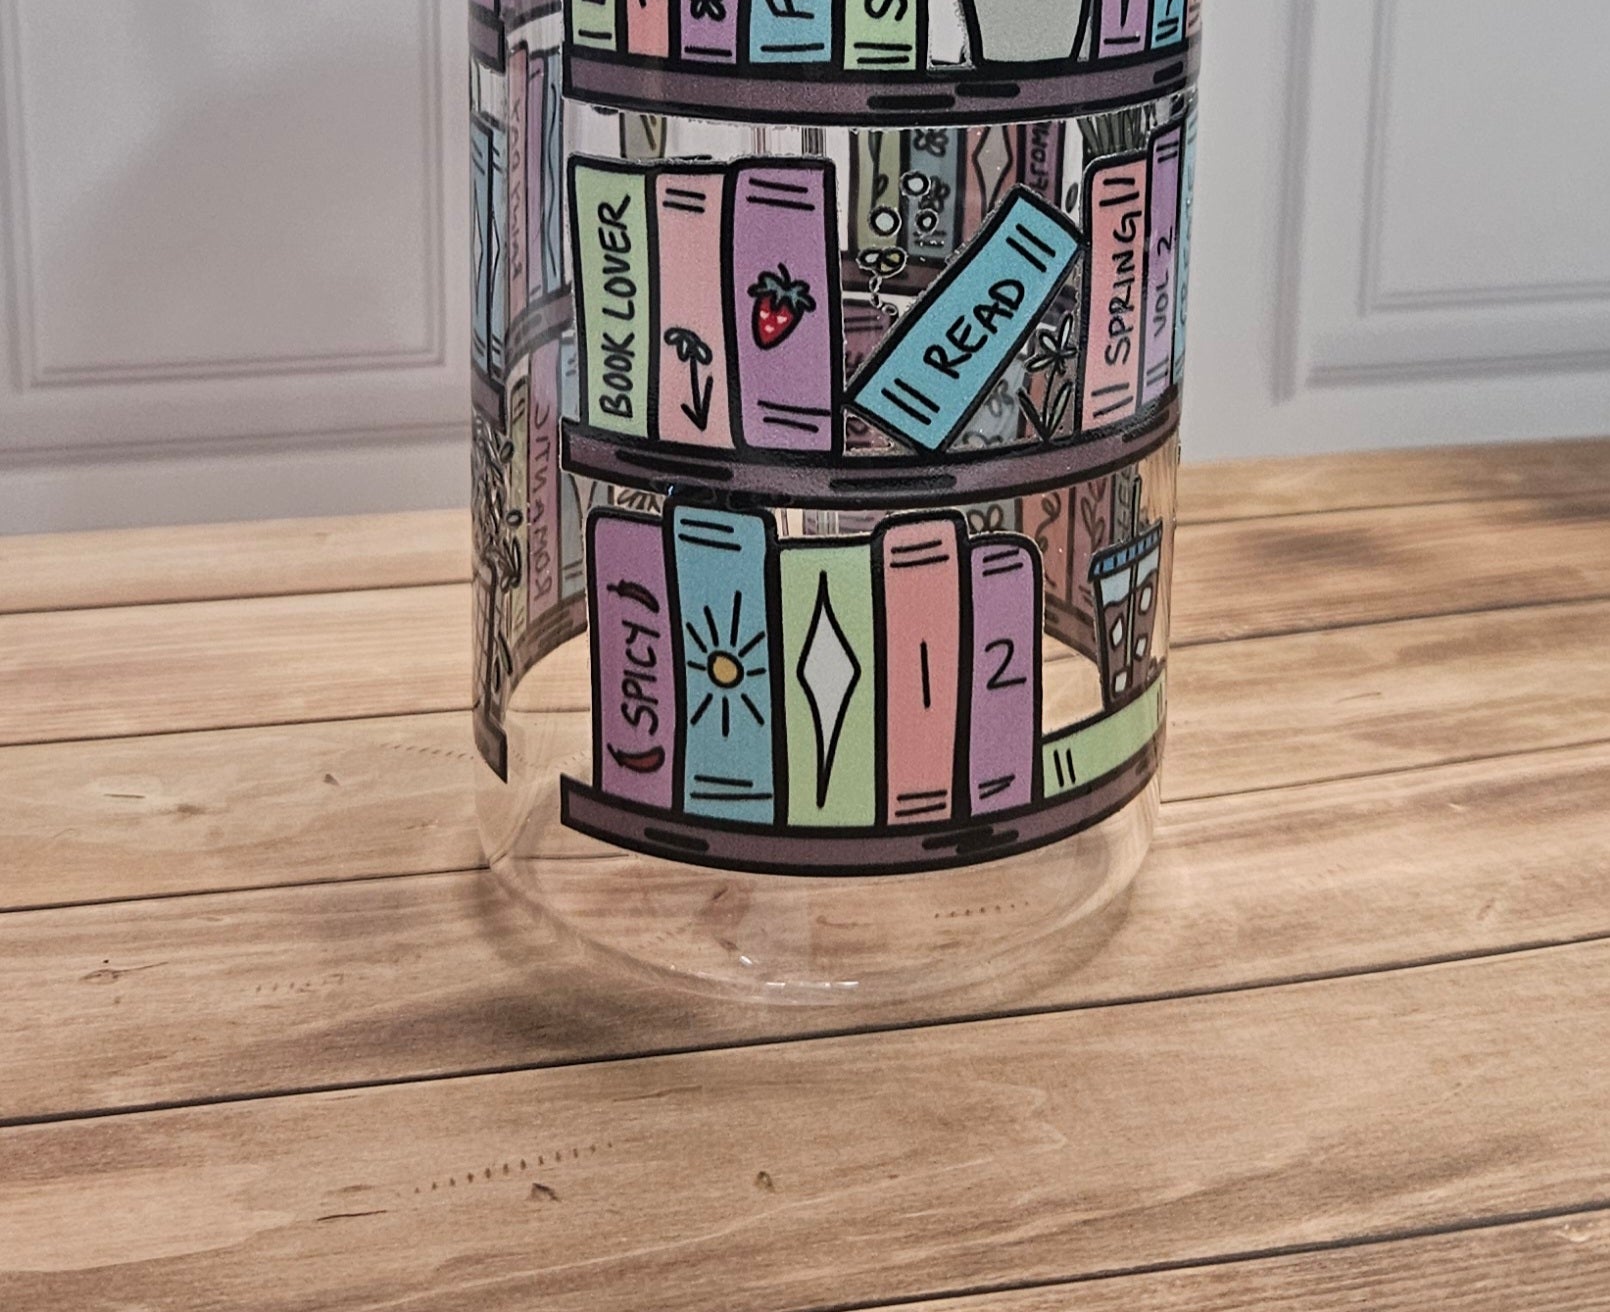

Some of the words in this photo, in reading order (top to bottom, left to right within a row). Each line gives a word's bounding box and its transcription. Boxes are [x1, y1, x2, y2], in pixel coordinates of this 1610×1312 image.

[597, 193, 637, 322] LOVER
[1104, 209, 1142, 366] SPRING
[1157, 225, 1173, 257] 2
[923, 278, 1026, 380] READ
[1153, 270, 1170, 338] VOL
[599, 332, 635, 418] BOOK
[621, 619, 661, 736] SPICY
[984, 638, 1028, 692] 2
